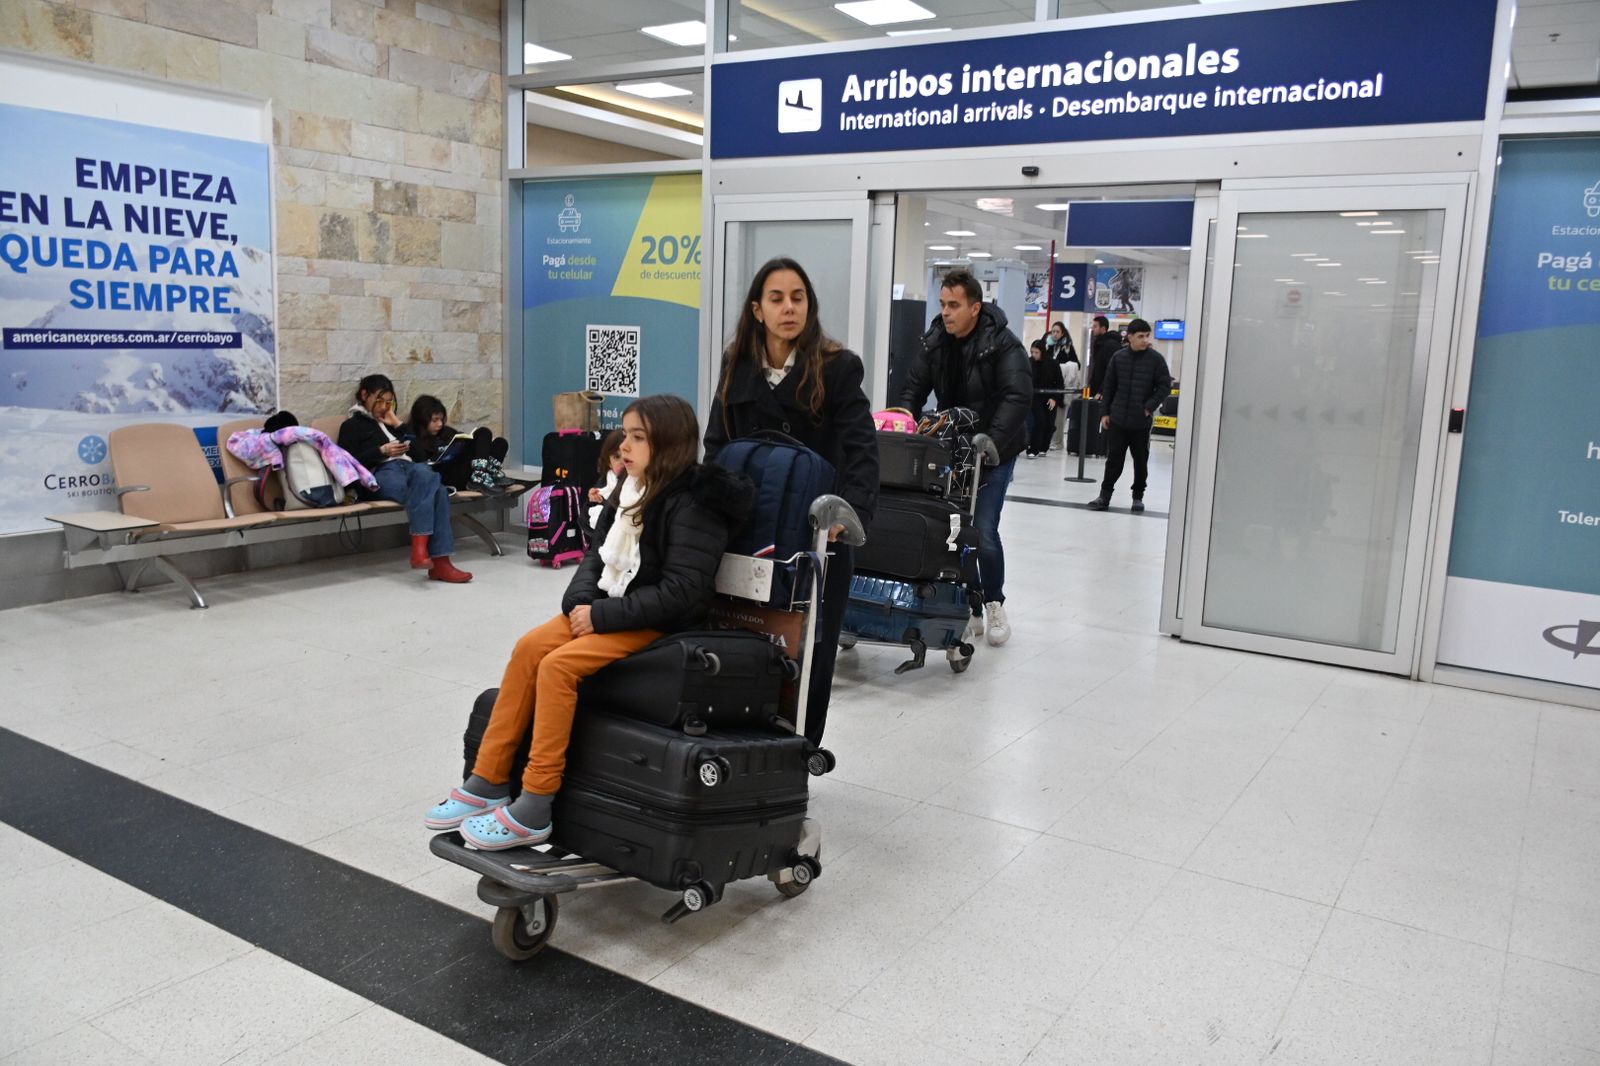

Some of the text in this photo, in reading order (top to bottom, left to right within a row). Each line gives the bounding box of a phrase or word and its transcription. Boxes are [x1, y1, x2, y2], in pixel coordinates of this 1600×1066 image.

[841, 43, 1240, 102] Arribos internacionales
[839, 72, 1384, 131] International arrivals Desembarque internacional
[75, 157, 237, 205] EMPIEZA
[0, 190, 238, 246] EN LA NIEVE,
[1552, 225, 1600, 236] Estacio
[0, 233, 240, 278] QUEDA PARA
[542, 254, 597, 268] Pagá desde
[641, 235, 702, 265] 20%
[1537, 251, 1593, 272] Pagá
[548, 268, 593, 280] tu celular
[640, 270, 652, 280] de
[1548, 275, 1571, 290] tu
[69, 279, 241, 314] SIEMPRE.
[1059, 275, 1076, 299] 3
[12, 330, 234, 346] americanexpress.com.ar/cerrobayo
[82, 488, 115, 497] BOUTIQ
